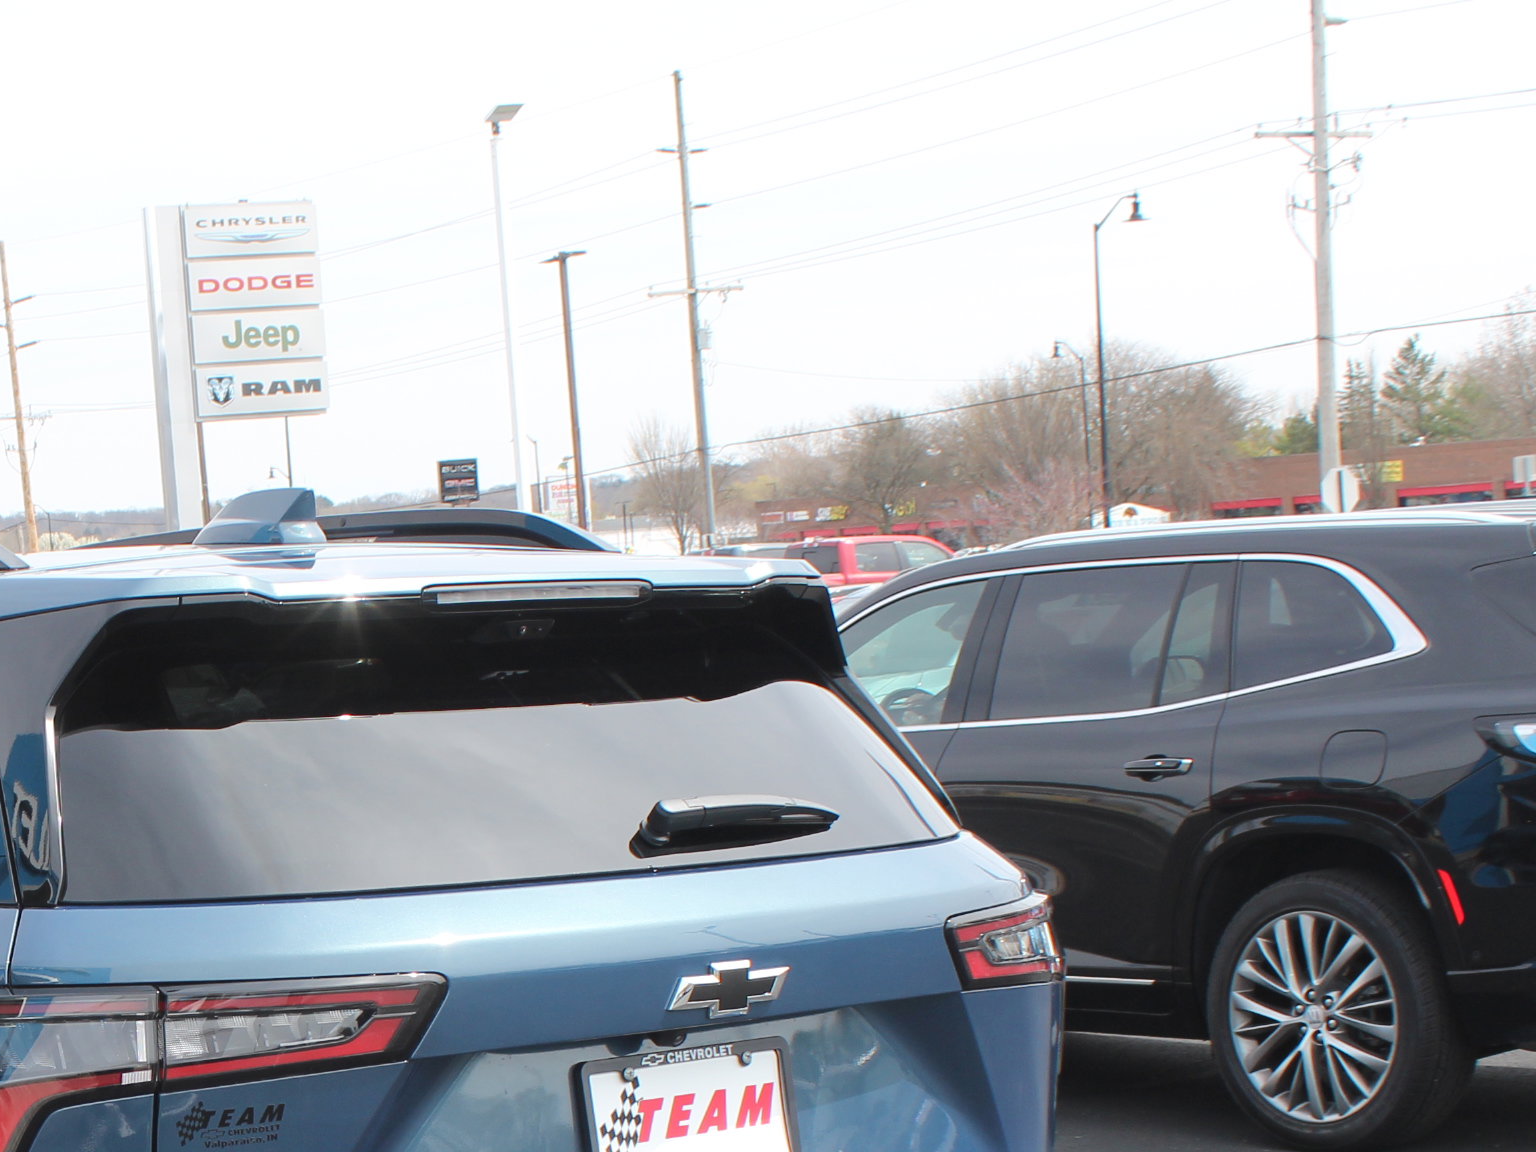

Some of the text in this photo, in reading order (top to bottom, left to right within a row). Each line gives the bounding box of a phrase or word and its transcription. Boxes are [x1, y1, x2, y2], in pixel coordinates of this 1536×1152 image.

[195, 215, 307, 229] CHRYSLER
[197, 274, 314, 294] DODGE
[222, 319, 300, 352] Jeep
[241, 378, 322, 396] RAM
[666, 1044, 733, 1064] CHEVROLET
[203, 1103, 285, 1129] TEAM
[638, 1082, 774, 1143] TEAM
[228, 1124, 280, 1136] CHEVROLET
